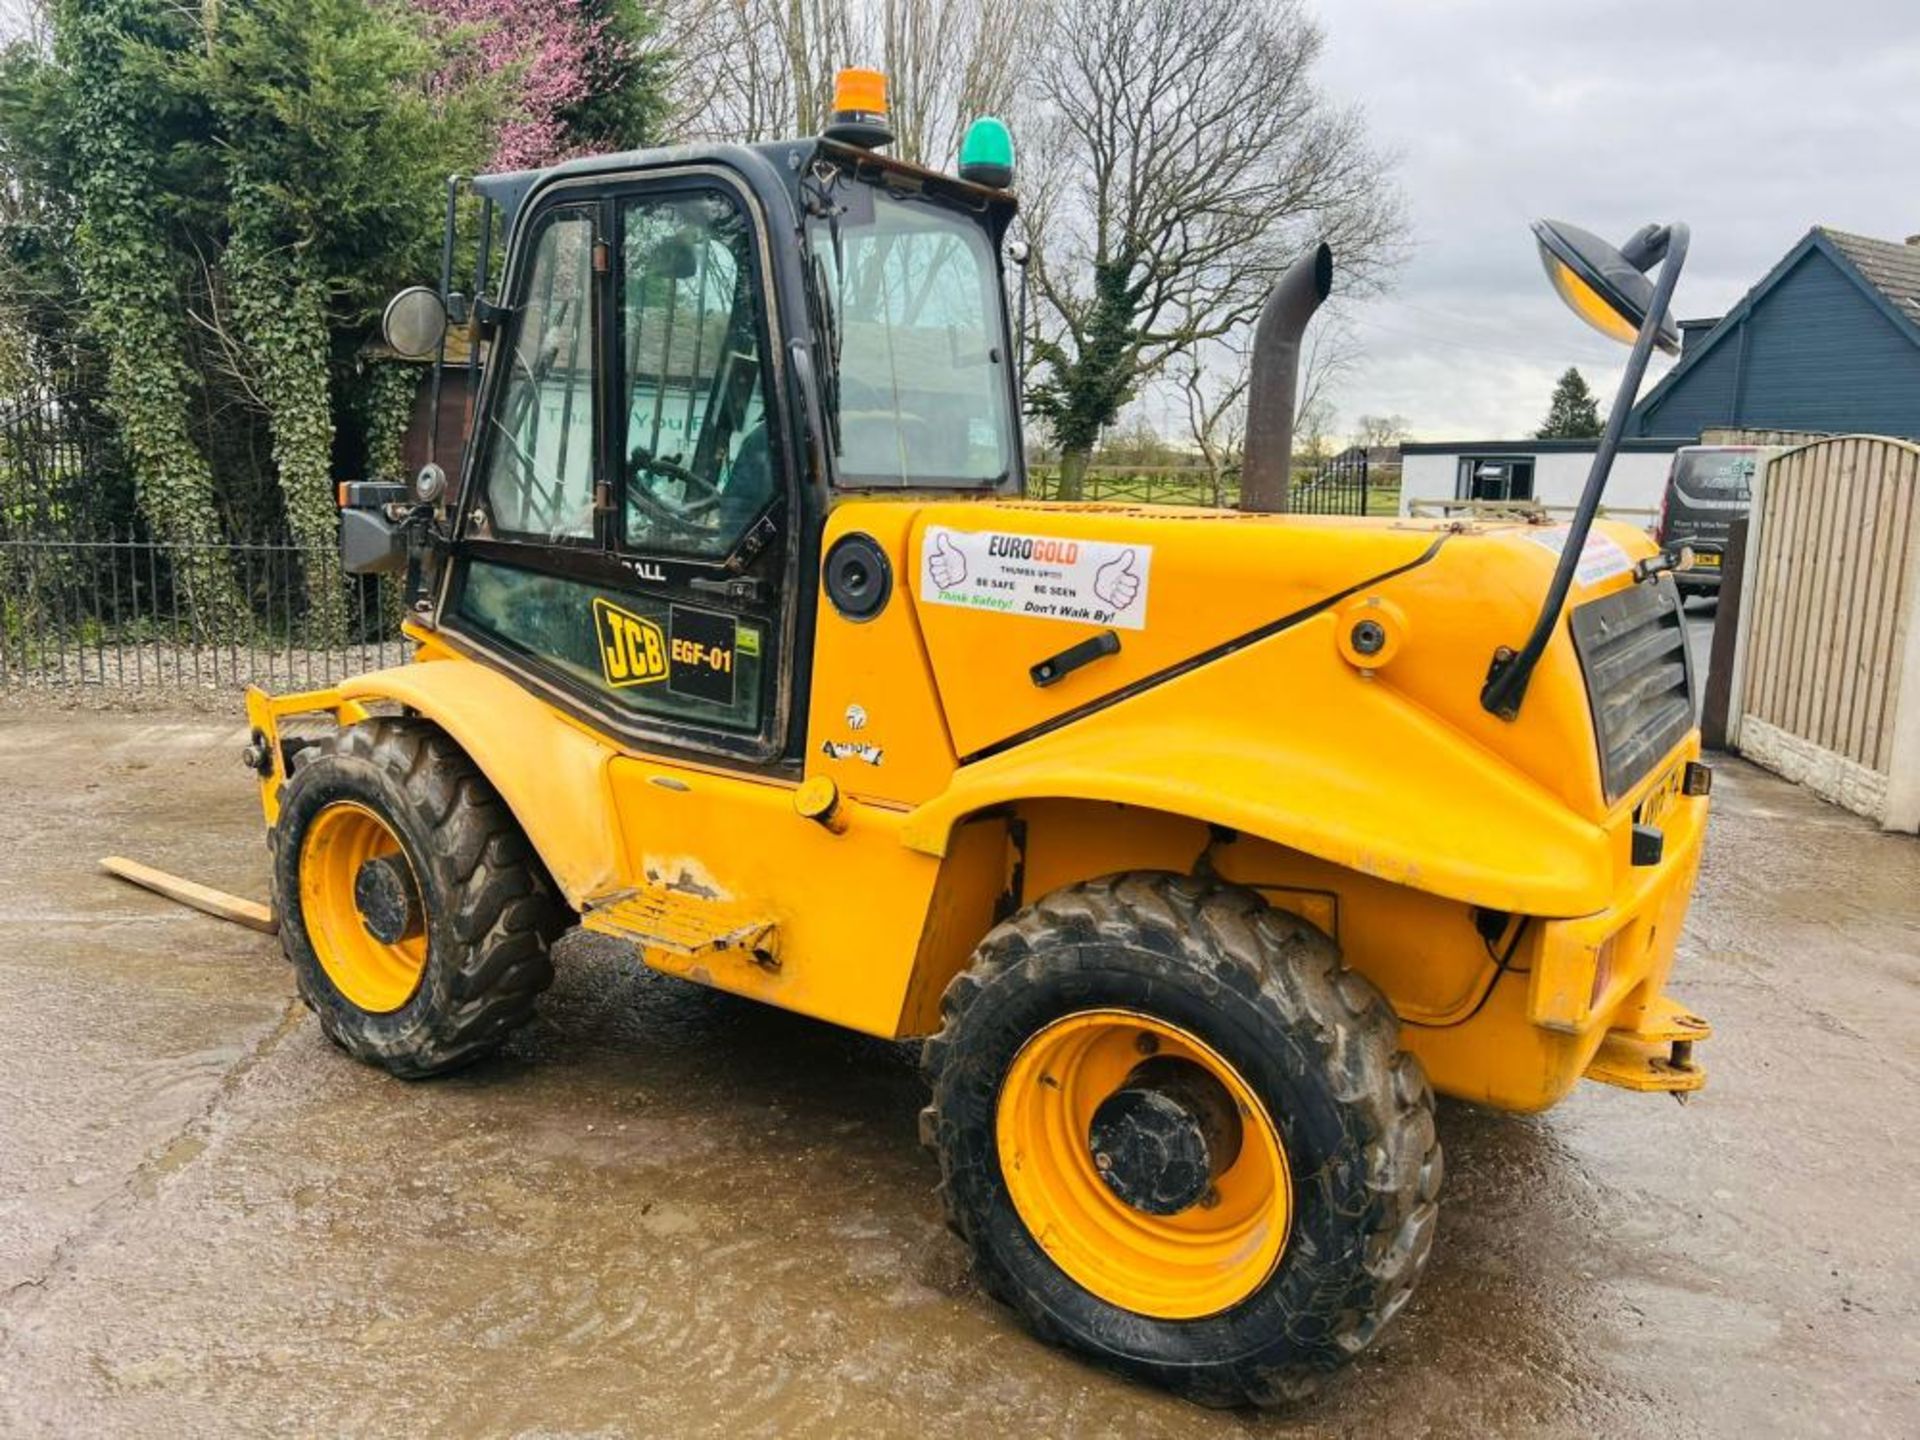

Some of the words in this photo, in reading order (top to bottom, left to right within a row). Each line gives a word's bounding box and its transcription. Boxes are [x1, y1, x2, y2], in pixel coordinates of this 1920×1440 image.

[988, 535, 1078, 565] EUROGOLD
[621, 561, 667, 581] ALL
[1001, 566, 1035, 577] THUMBS
[976, 577, 988, 587] BE
[991, 579, 1015, 590] SAFE
[1034, 584, 1047, 594] BE
[1050, 586, 1076, 597] SEEN
[937, 591, 967, 602] Think
[971, 594, 1014, 609] Safety!
[1024, 601, 1057, 615] Don't
[1060, 605, 1090, 619] Walk
[1094, 610, 1115, 623] By!
[606, 609, 663, 679] JCB
[672, 638, 731, 673] EGF-01
